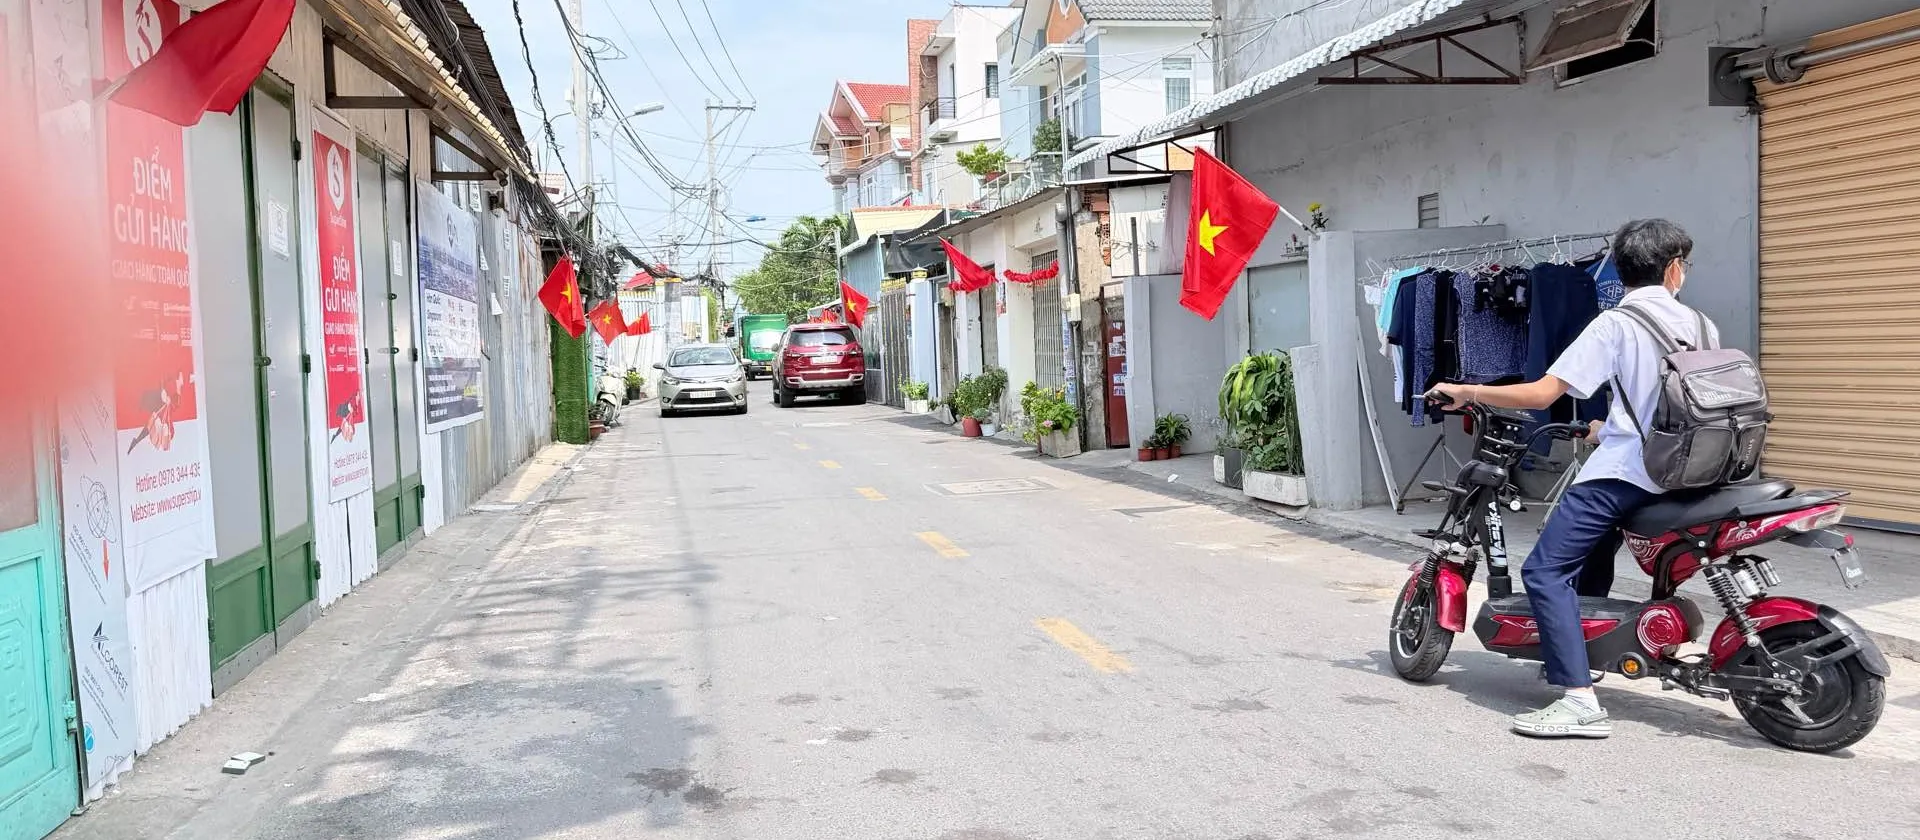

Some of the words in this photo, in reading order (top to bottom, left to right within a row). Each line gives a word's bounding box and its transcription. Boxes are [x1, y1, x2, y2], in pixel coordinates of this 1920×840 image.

[133, 145, 172, 203] ĐIỂM
[114, 193, 145, 246] GỬI
[157, 261, 176, 285] TOÀN
[176, 264, 192, 289] QUỐ
[332, 245, 351, 283] ĐIỂM
[325, 278, 340, 312] GỬI
[1607, 285, 1622, 297] HP
[135, 472, 158, 493] Hotline:
[158, 467, 175, 488] 0978
[176, 464, 189, 483] 344
[130, 500, 156, 523] Website:
[157, 486, 202, 515] www.supership.v
[1487, 501, 1504, 551] ASUKA
[1533, 724, 1570, 733] crocs
